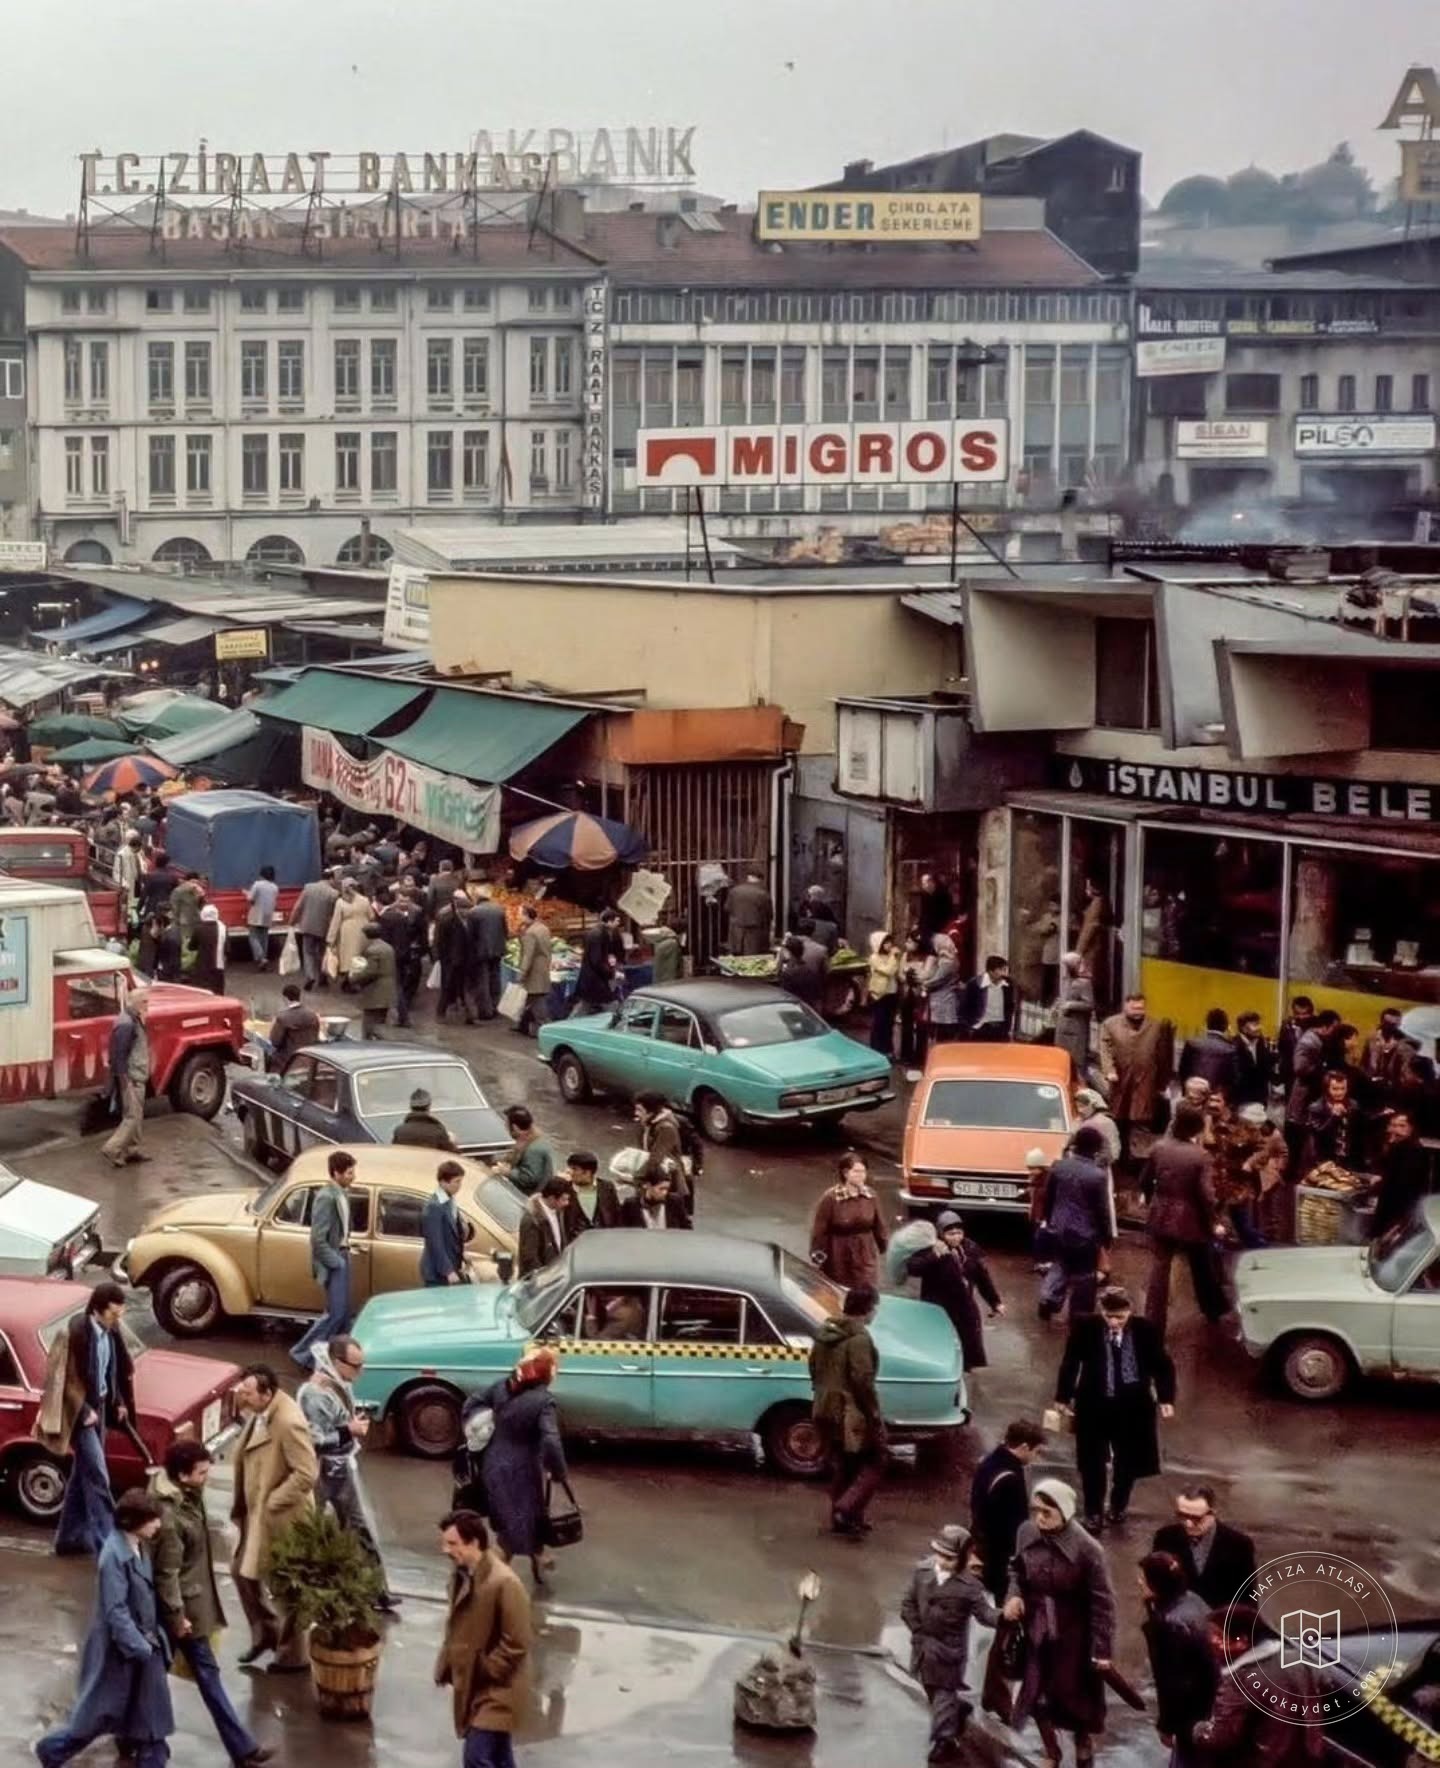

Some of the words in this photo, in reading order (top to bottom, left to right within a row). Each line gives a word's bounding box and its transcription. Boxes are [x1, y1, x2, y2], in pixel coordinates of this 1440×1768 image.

[168, 142, 329, 193] ZİRAAT
[359, 151, 558, 193] BANKASI
[472, 127, 696, 177] AKBANK
[767, 202, 875, 230] ENDER
[733, 431, 998, 475] MIGROS
[385, 755, 407, 814] 62
